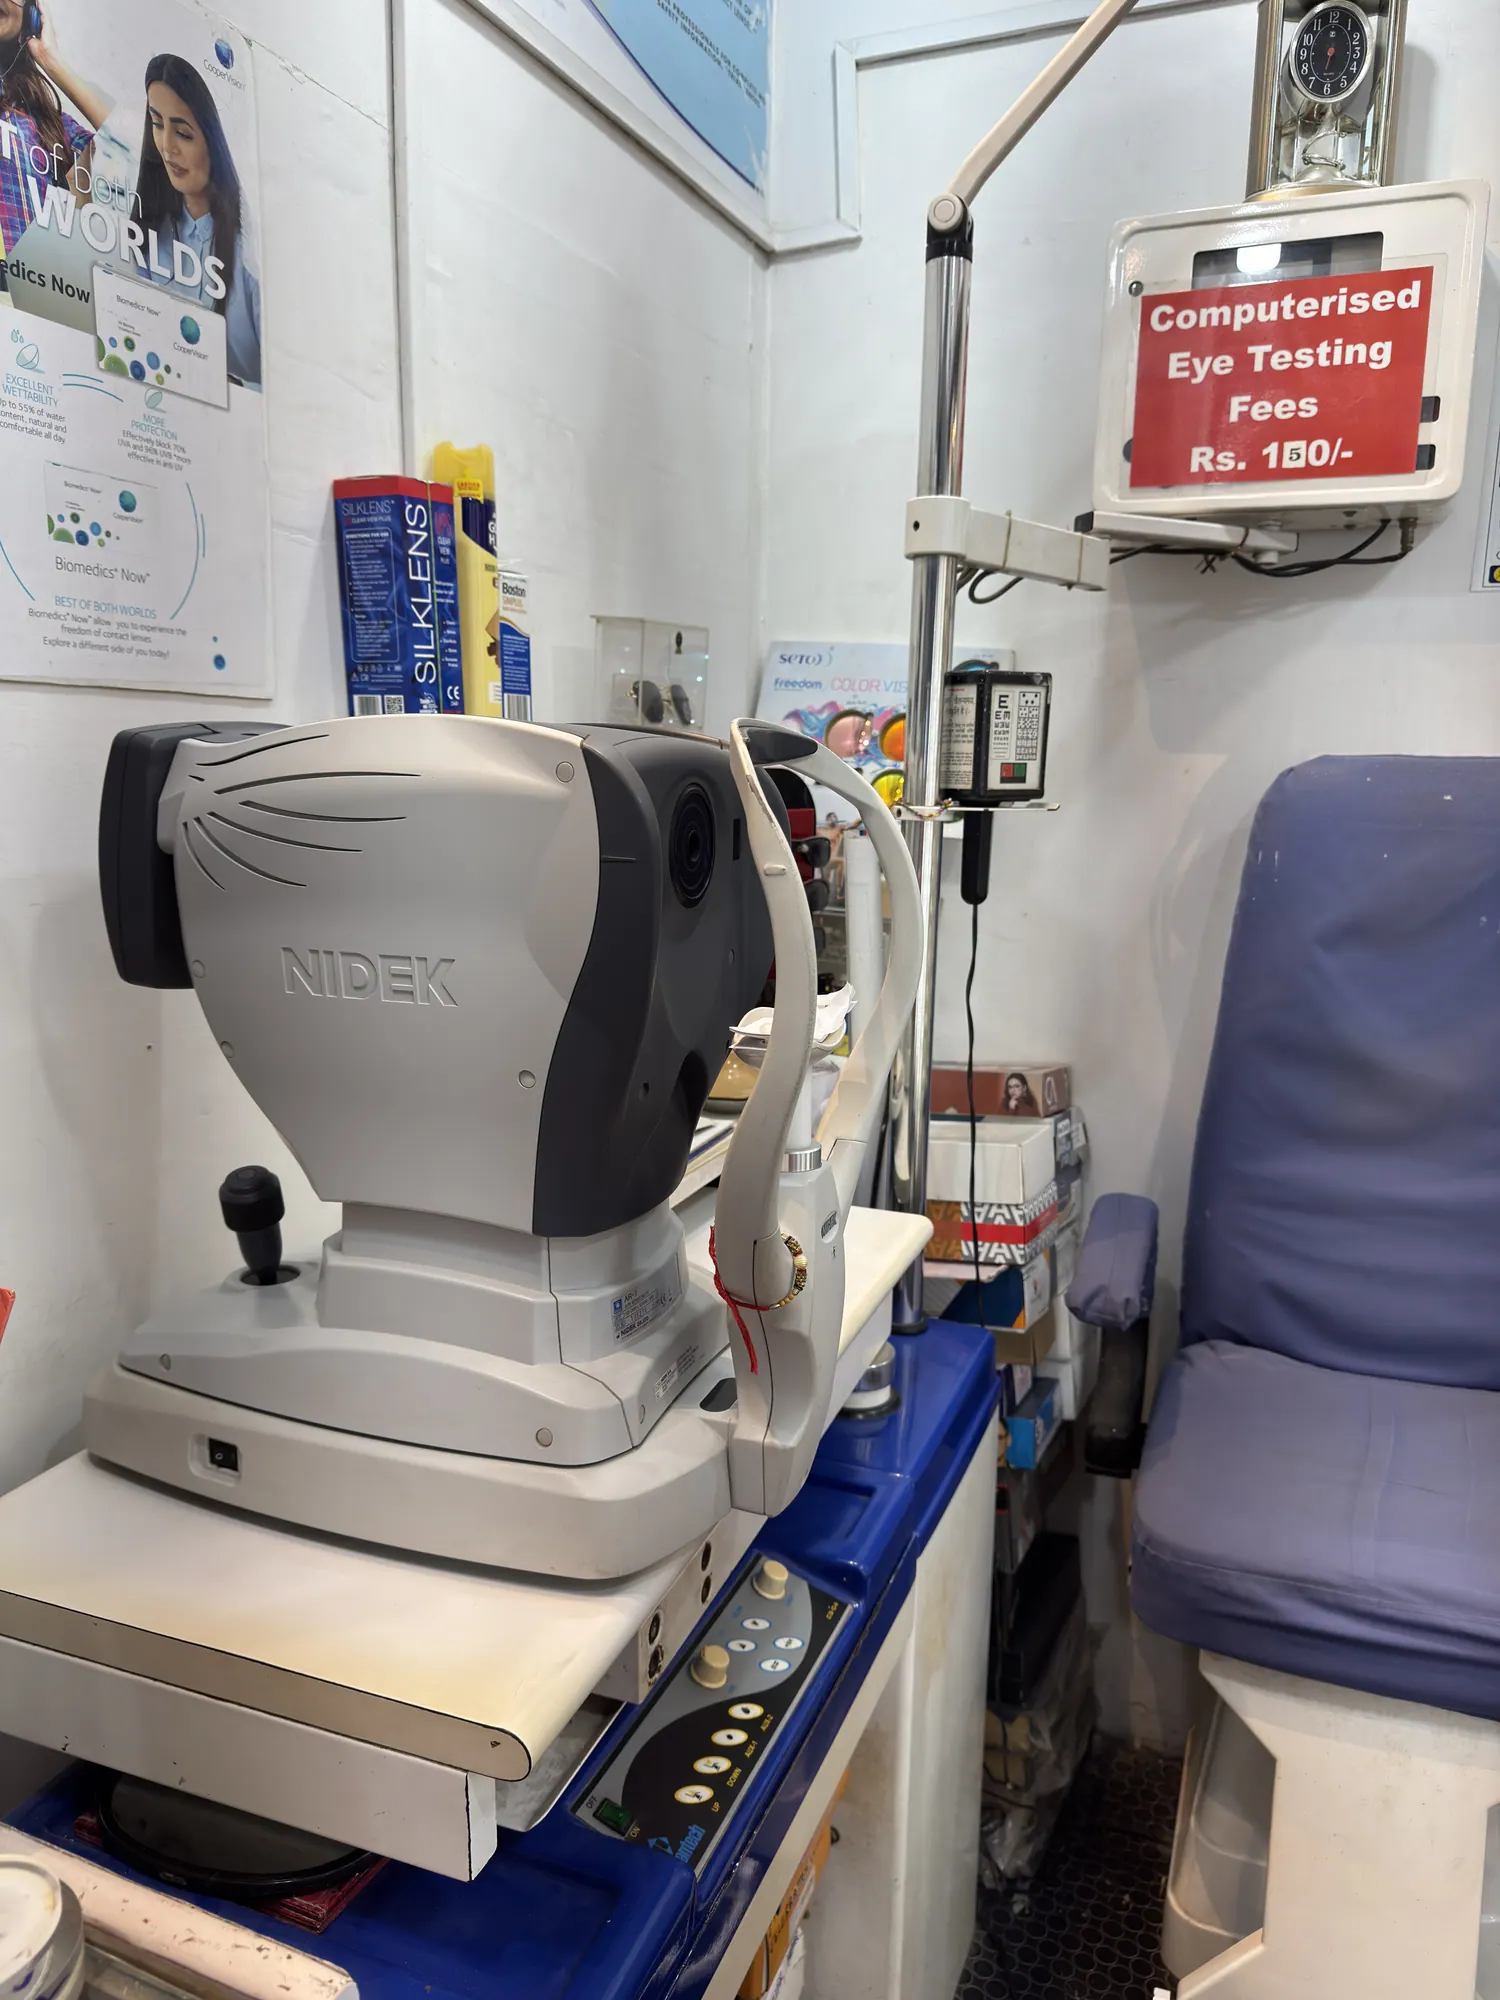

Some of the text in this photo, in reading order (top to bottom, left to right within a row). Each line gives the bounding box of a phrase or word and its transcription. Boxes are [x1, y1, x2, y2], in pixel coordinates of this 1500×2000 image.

[1313, 19, 1321, 31] 11
[1329, 11, 1340, 23] 12
[1347, 18, 1352, 31] 1
[1303, 33, 1313, 46] 10
[1352, 32, 1360, 45] 2
[1300, 48, 1307, 60] 9
[1352, 47, 1361, 59] 3
[203, 59, 246, 92] CooperVision
[1301, 62, 1309, 75] 8
[1349, 61, 1357, 74] 4
[1308, 77, 1316, 89] 7
[1323, 83, 1331, 95] 6
[1340, 76, 1347, 88] 5
[29, 142, 64, 181] of
[73, 151, 143, 219] both
[26, 174, 227, 300] WORLDS
[51, 275, 91, 304] Now
[1150, 281, 1422, 333] Computerised
[173, 342, 208, 360] CooperVision
[1168, 338, 1392, 384] Eye Testing
[6, 373, 54, 396] EXCELLENT
[2, 384, 59, 408] WETTABILITY
[9, 401, 17, 410] to
[19, 402, 36, 415] 55%
[37, 408, 44, 417] of
[46, 411, 66, 423] water
[1229, 395, 1318, 423] Fees
[28, 417, 53, 430] natural
[54, 424, 67, 434] and
[143, 413, 165, 428] MORE
[44, 431, 52, 440] all
[53, 433, 66, 445] day
[131, 420, 178, 441] PROTECTION
[118, 438, 131, 448] UVA
[132, 443, 143, 452] and
[122, 430, 155, 447] Effectively
[155, 439, 171, 450] block
[127, 451, 154, 465] effective
[1190, 437, 1353, 473] Rs. 150/-
[342, 499, 392, 516] SILKLENS
[405, 503, 437, 684] SILKLENS
[502, 582, 526, 598] Boston
[55, 595, 157, 619] BEST OF BOTH WORLDS
[61, 624, 92, 637] freedom
[93, 628, 102, 637] of
[102, 631, 130, 641] contact
[116, 621, 129, 631] you
[139, 624, 174, 636] experience
[176, 627, 187, 637] the
[43, 636, 70, 649] Explore
[78, 640, 109, 652] different
[110, 643, 125, 654] side
[134, 648, 148, 658] you
[149, 648, 170, 660] today!
[773, 677, 822, 691] freedom
[830, 676, 880, 693] COLOR
[446, 686, 460, 700] CE
[998, 694, 1009, 709] E
[281, 946, 458, 1007] NIDEK
[621, 1322, 637, 1337] NIDEK
[726, 1766, 742, 1788] DOWN
[585, 1795, 596, 1809] OFF
[711, 1801, 720, 1812] UP
[629, 1825, 641, 1838] ON
